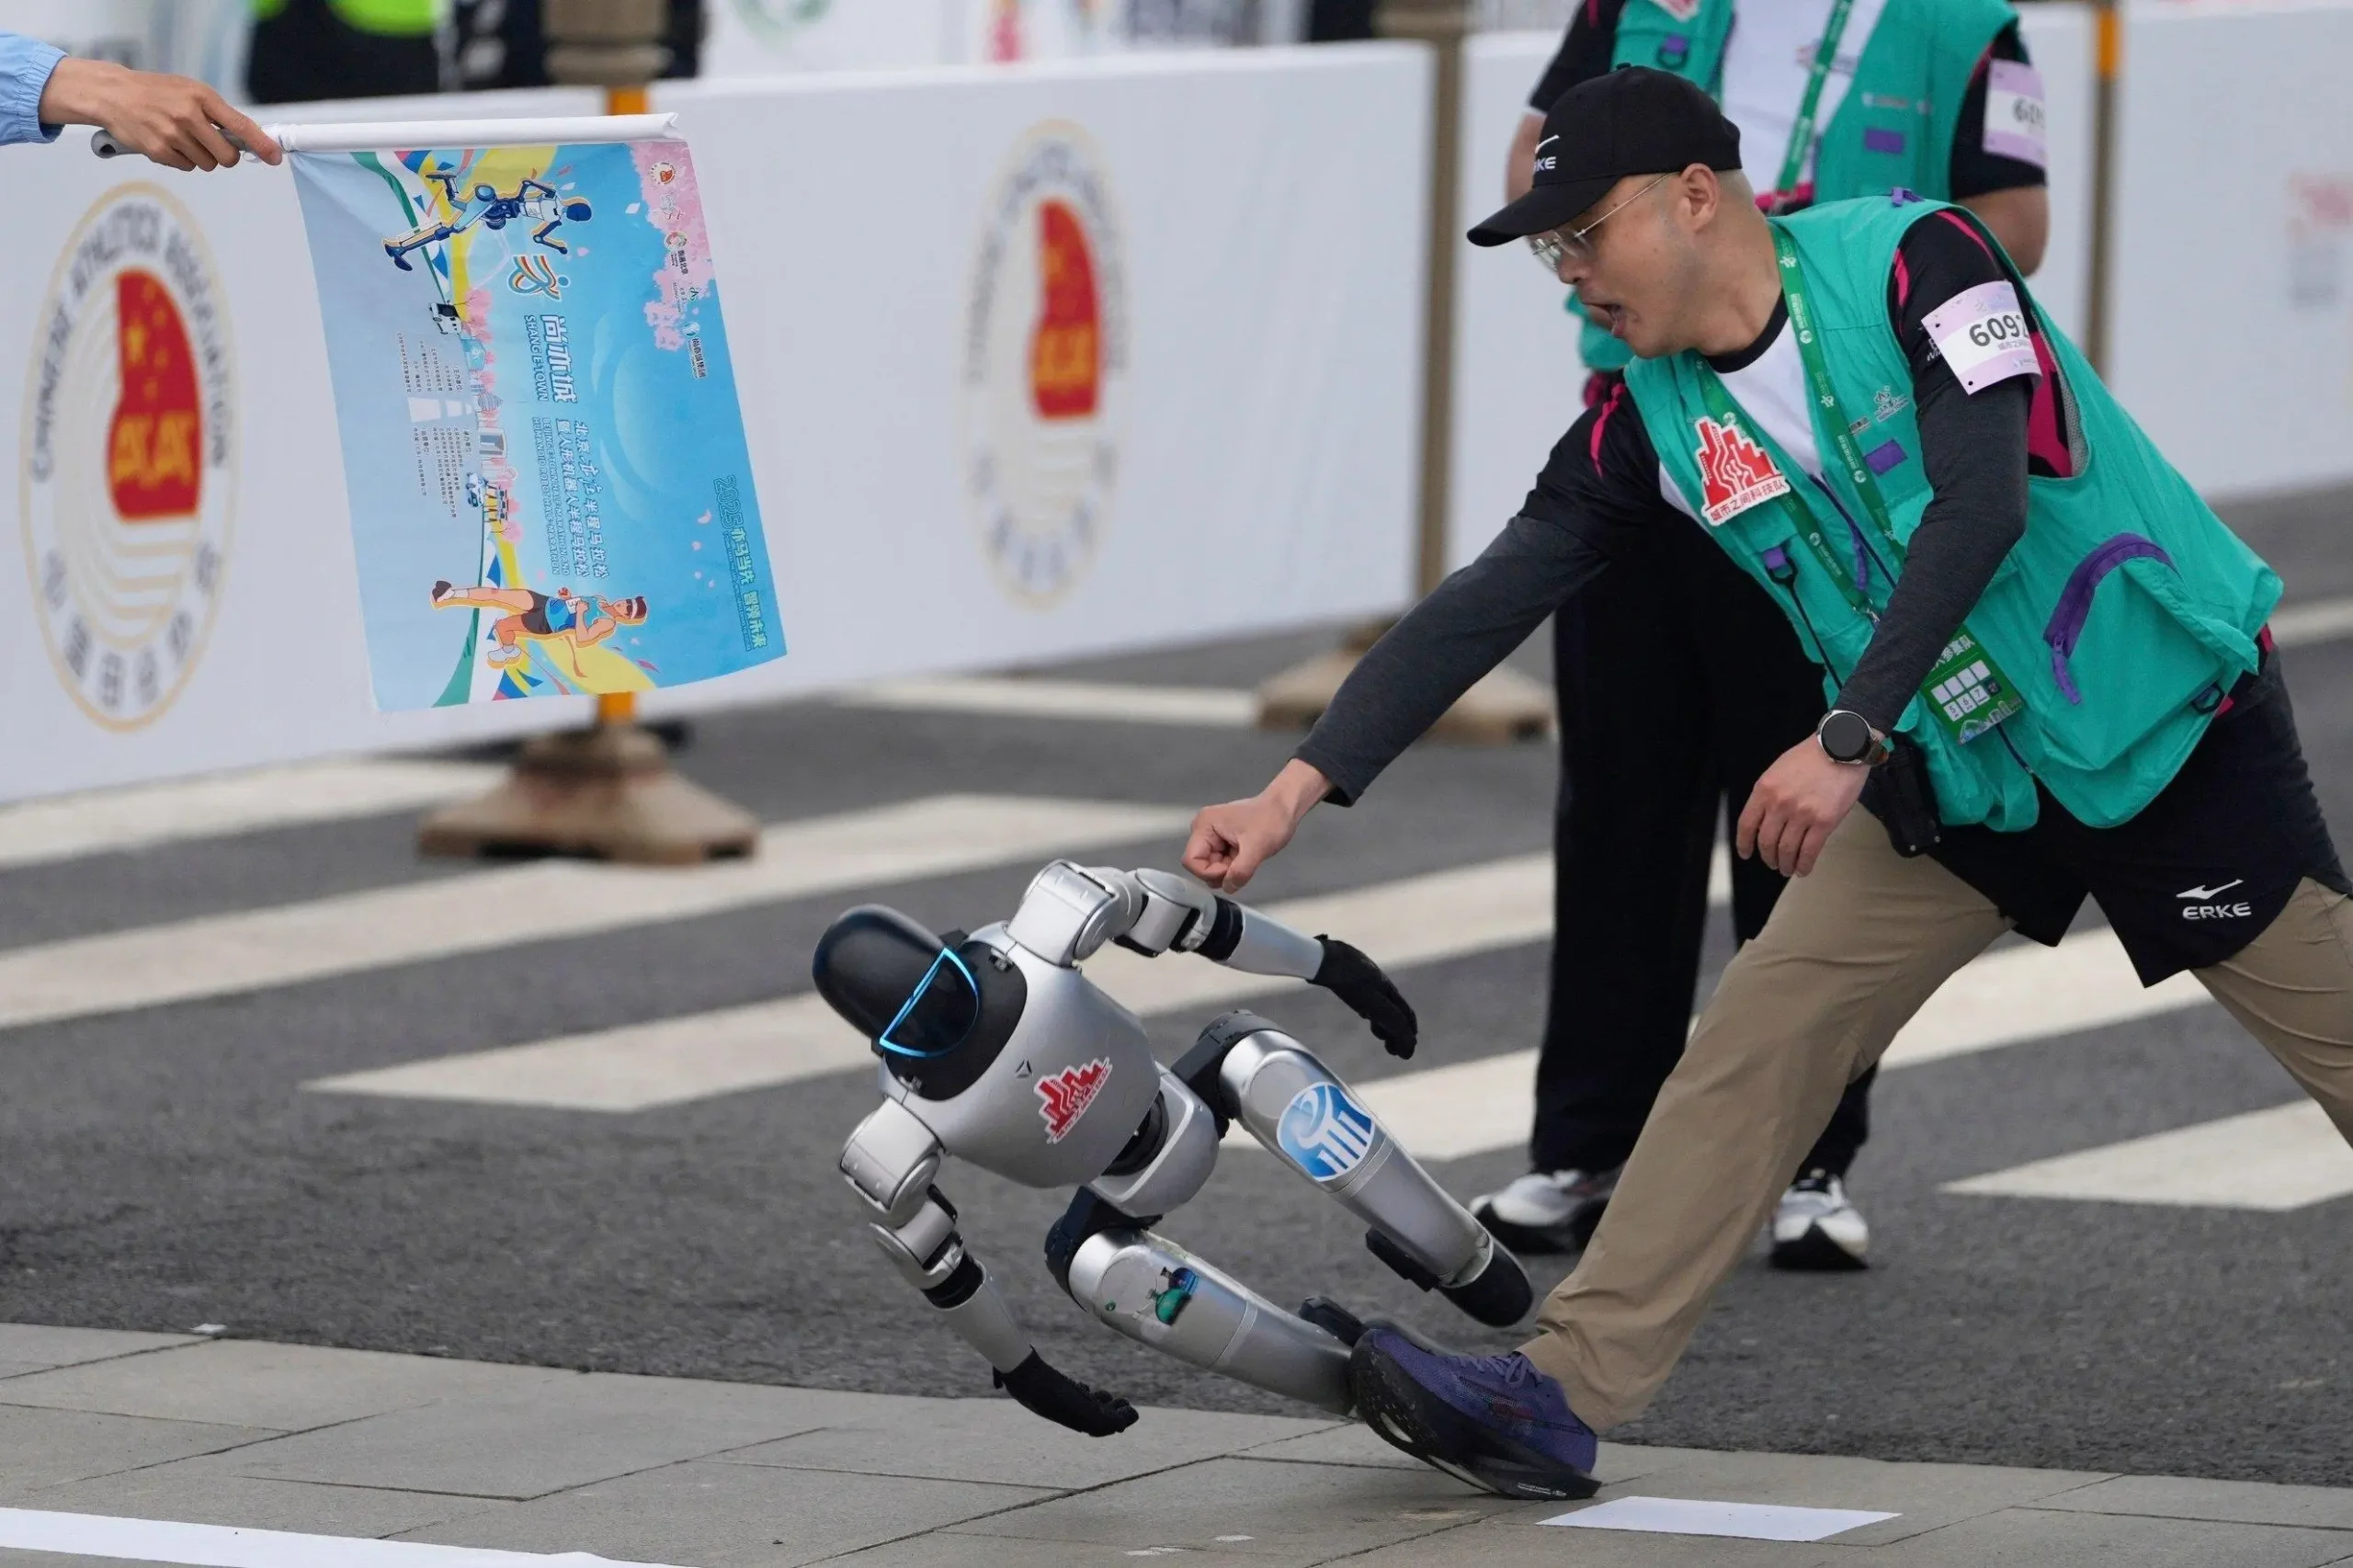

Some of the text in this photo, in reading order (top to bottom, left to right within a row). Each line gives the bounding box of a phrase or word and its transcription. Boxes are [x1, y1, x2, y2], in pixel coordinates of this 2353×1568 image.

[524, 314, 550, 403] SHANG E-TOWN
[540, 314, 578, 403] 尚亦城
[532, 417, 547, 466] HUMANOID
[539, 467, 551, 498] ROBOT
[541, 417, 555, 448] BEIJING
[560, 556, 571, 576] AND
[555, 417, 590, 578] 暨人形机器人半程马拉松
[1710, 478, 1787, 522] 城市之间科技队
[713, 474, 768, 649] 2025 亦马当先 智领未来
[1930, 634, 1976, 672] 人参赛队
[2182, 902, 2253, 920] ERKE
